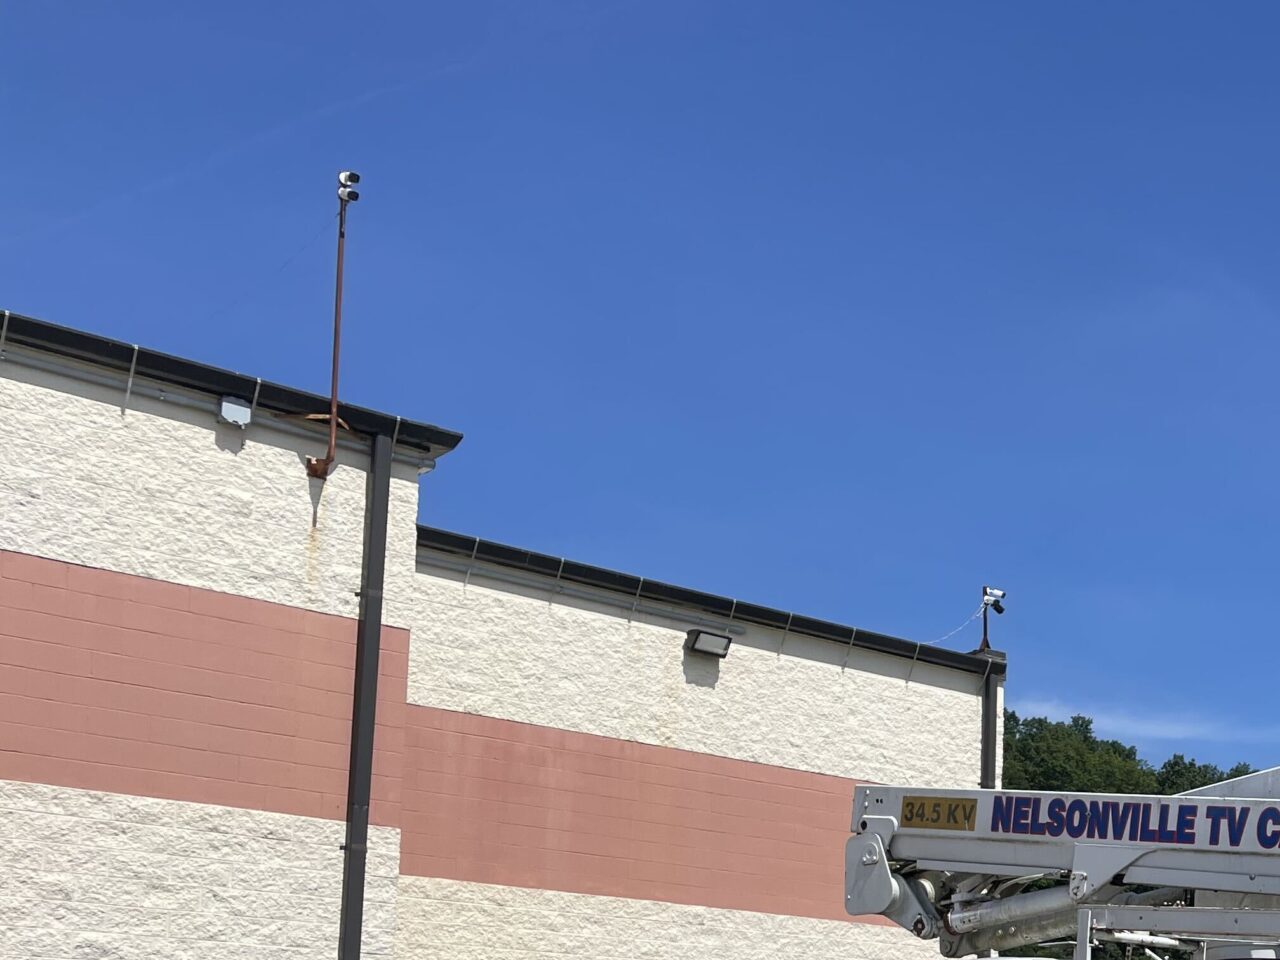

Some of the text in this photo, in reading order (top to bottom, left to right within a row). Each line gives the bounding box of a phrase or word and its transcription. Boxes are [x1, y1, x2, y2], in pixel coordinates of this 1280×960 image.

[904, 802, 941, 823] 34.5
[991, 796, 1198, 844] NELSONVILLE
[1206, 806, 1250, 847] TV
